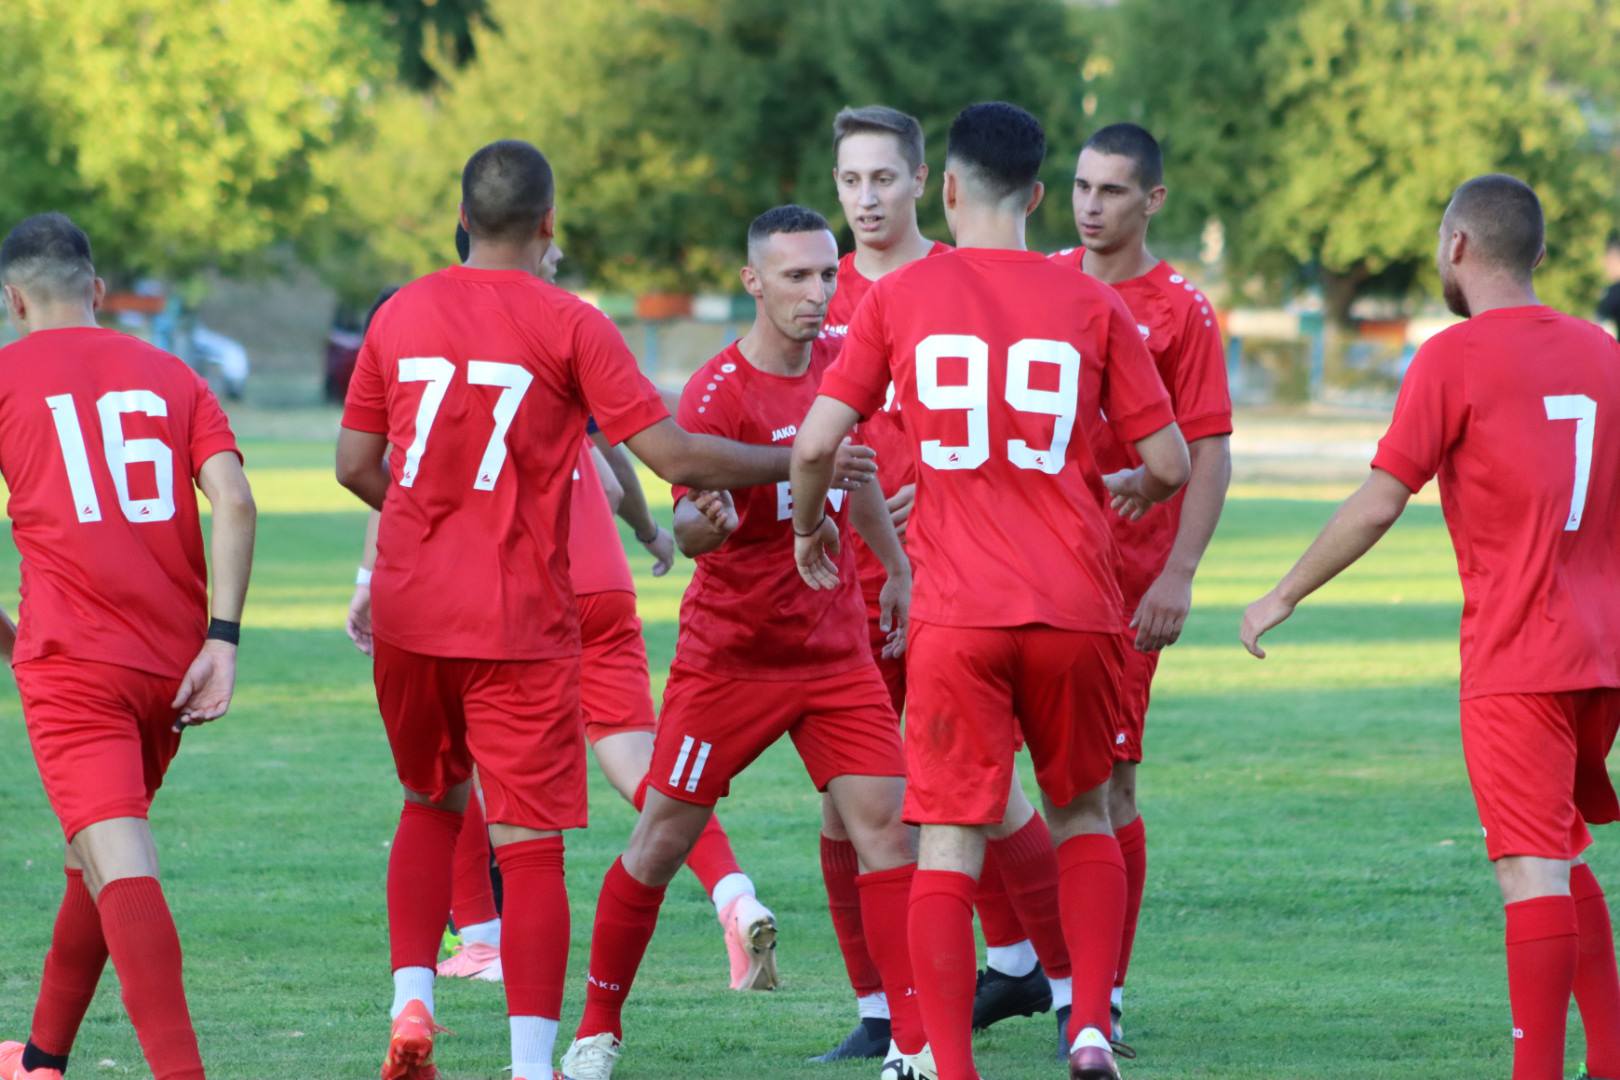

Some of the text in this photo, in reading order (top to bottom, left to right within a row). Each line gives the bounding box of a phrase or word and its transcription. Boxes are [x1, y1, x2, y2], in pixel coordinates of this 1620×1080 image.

[45, 390, 176, 523] 16
[398, 356, 534, 491] 77
[771, 425, 797, 441] JAKO
[915, 334, 1081, 475] 99
[1543, 394, 1597, 531] 7
[668, 735, 712, 793] 11
